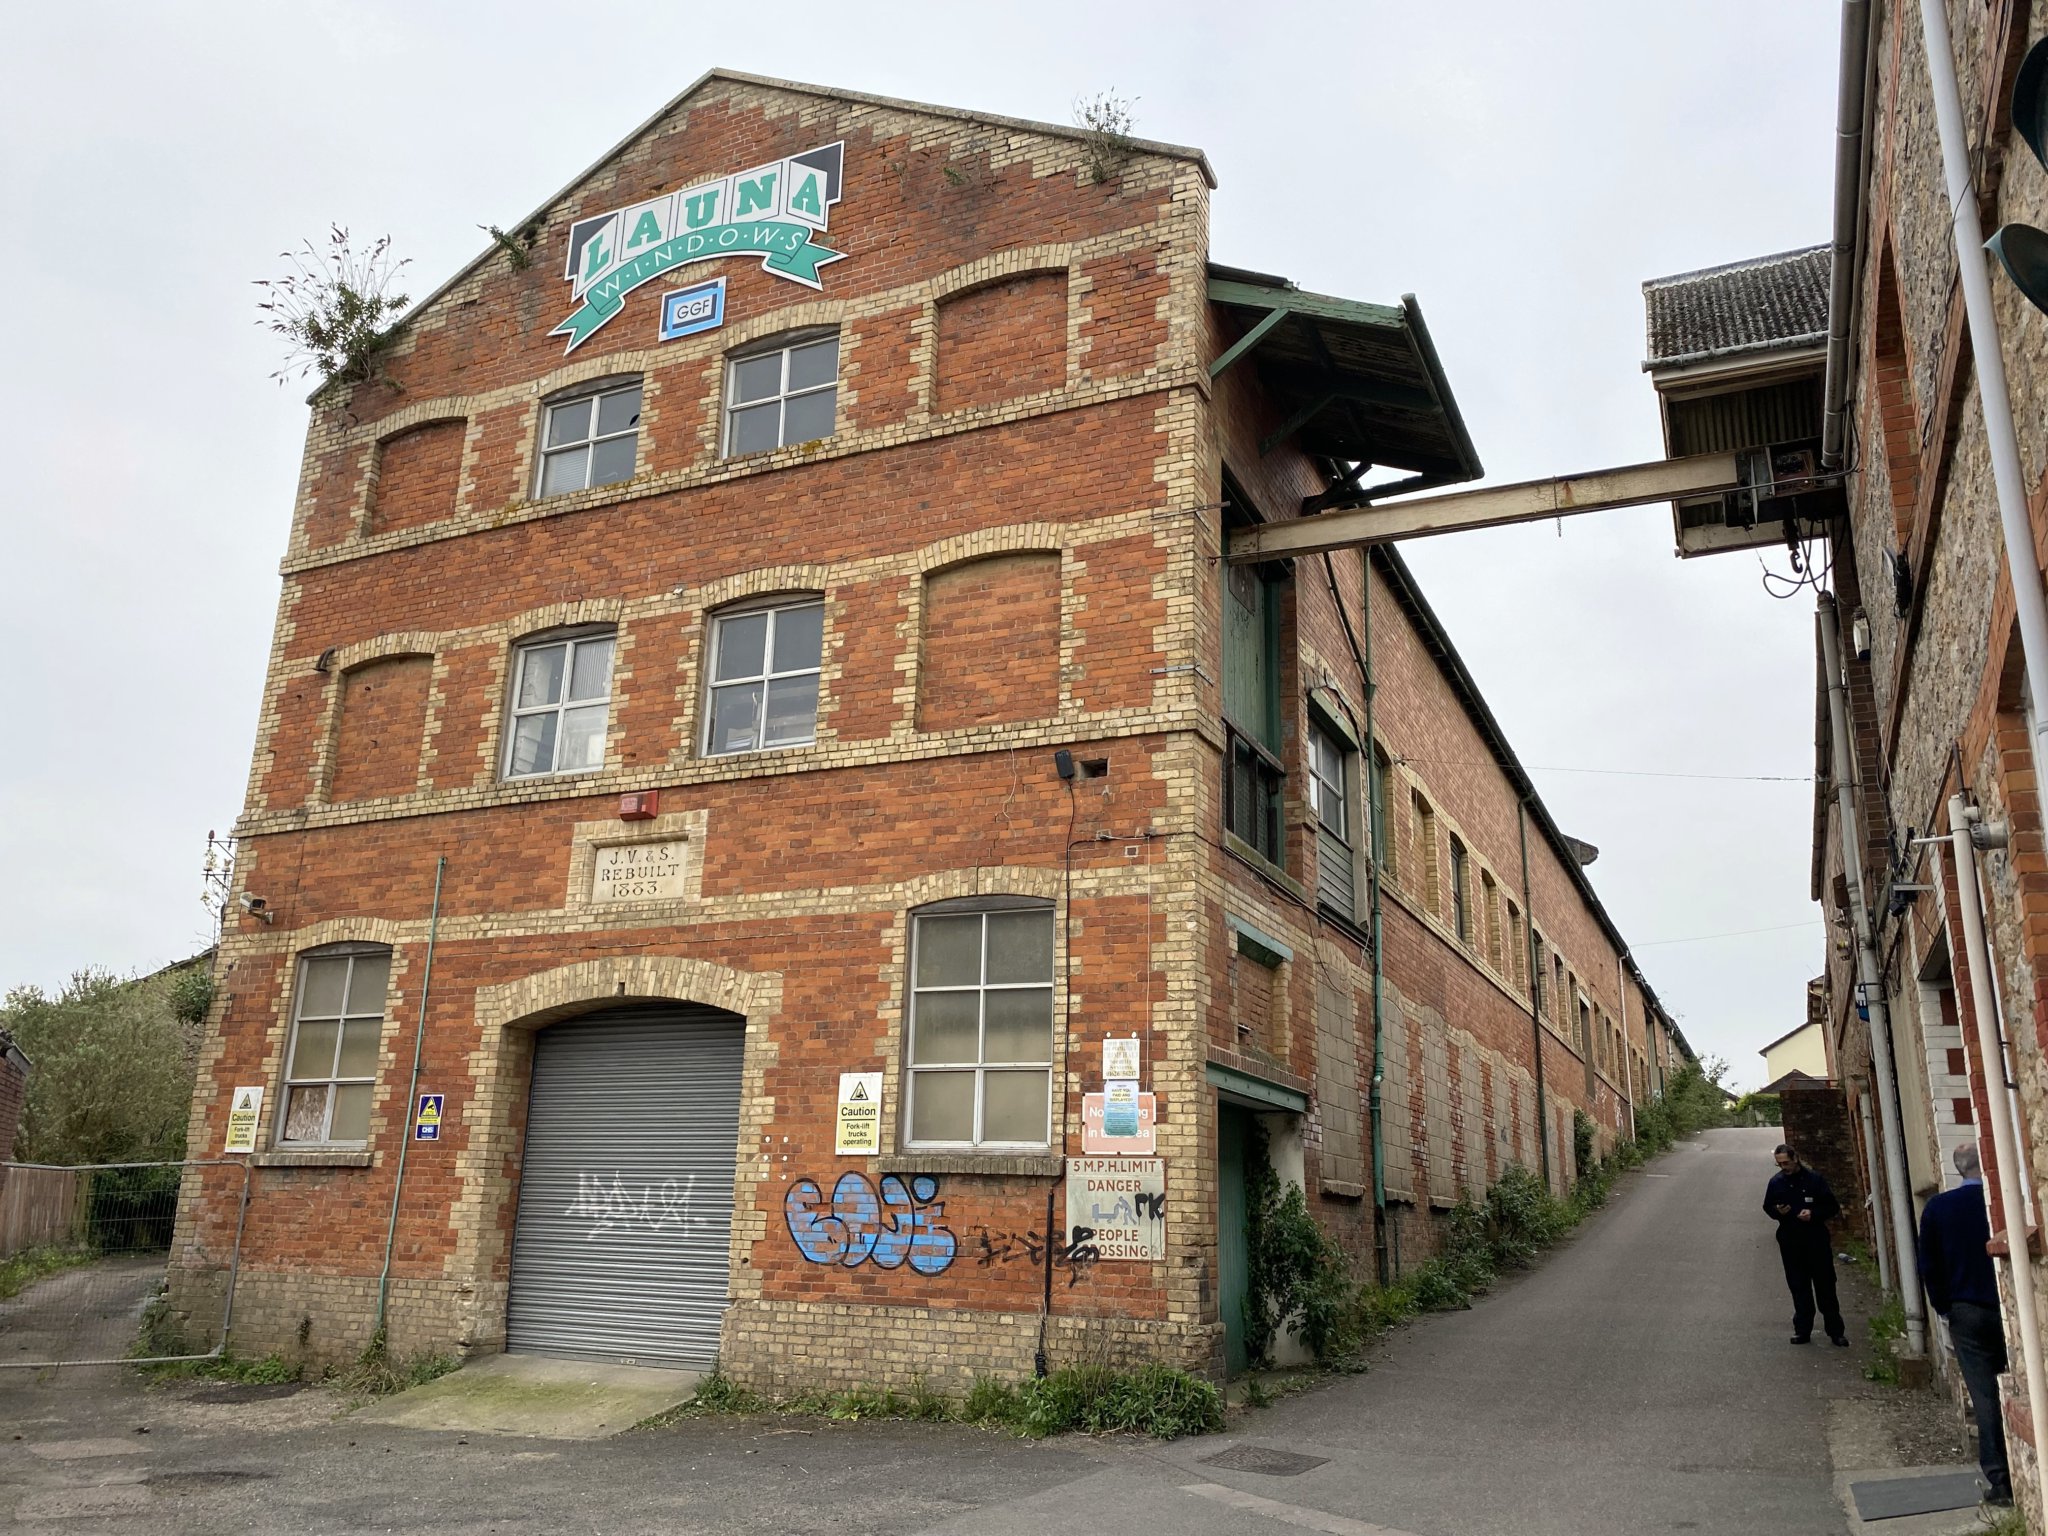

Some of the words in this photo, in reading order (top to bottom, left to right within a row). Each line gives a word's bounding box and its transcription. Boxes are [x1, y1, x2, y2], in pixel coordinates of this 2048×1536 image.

[584, 172, 821, 283] LAUNA
[676, 299, 711, 320] GGF
[601, 864, 680, 882] REBUILT
[232, 1113, 256, 1122] Caution
[841, 1106, 876, 1117] Caution
[1089, 1107, 1104, 1118] No
[842, 1139, 872, 1147] operating
[1073, 1160, 1080, 1172] 5
[1087, 1180, 1142, 1192] DANGER
[1082, 1244, 1148, 1257] OSSING
